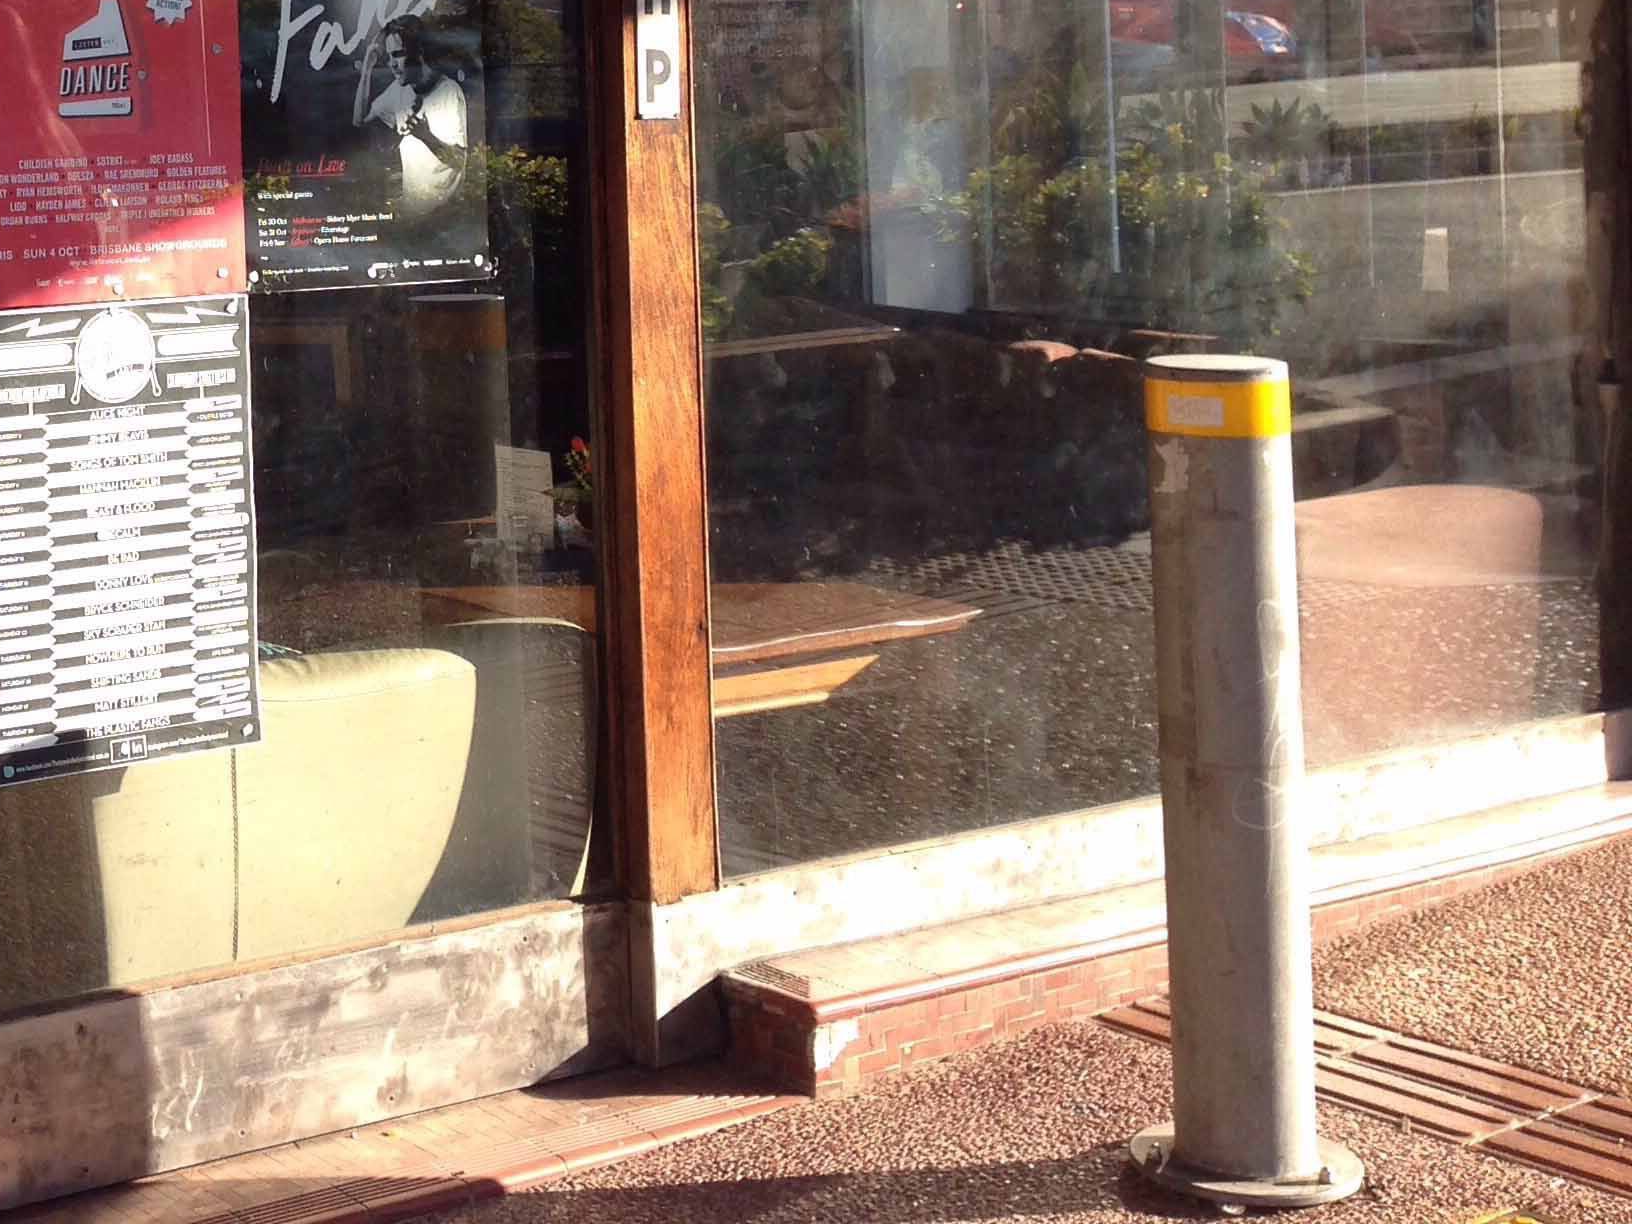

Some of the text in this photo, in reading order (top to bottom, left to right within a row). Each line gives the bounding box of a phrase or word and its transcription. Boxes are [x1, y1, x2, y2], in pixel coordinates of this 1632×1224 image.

[60, 63, 131, 95] DANCE
[24, 249, 46, 259] SUN
[59, 247, 80, 257] OCT
[90, 244, 143, 255] BRISBANE
